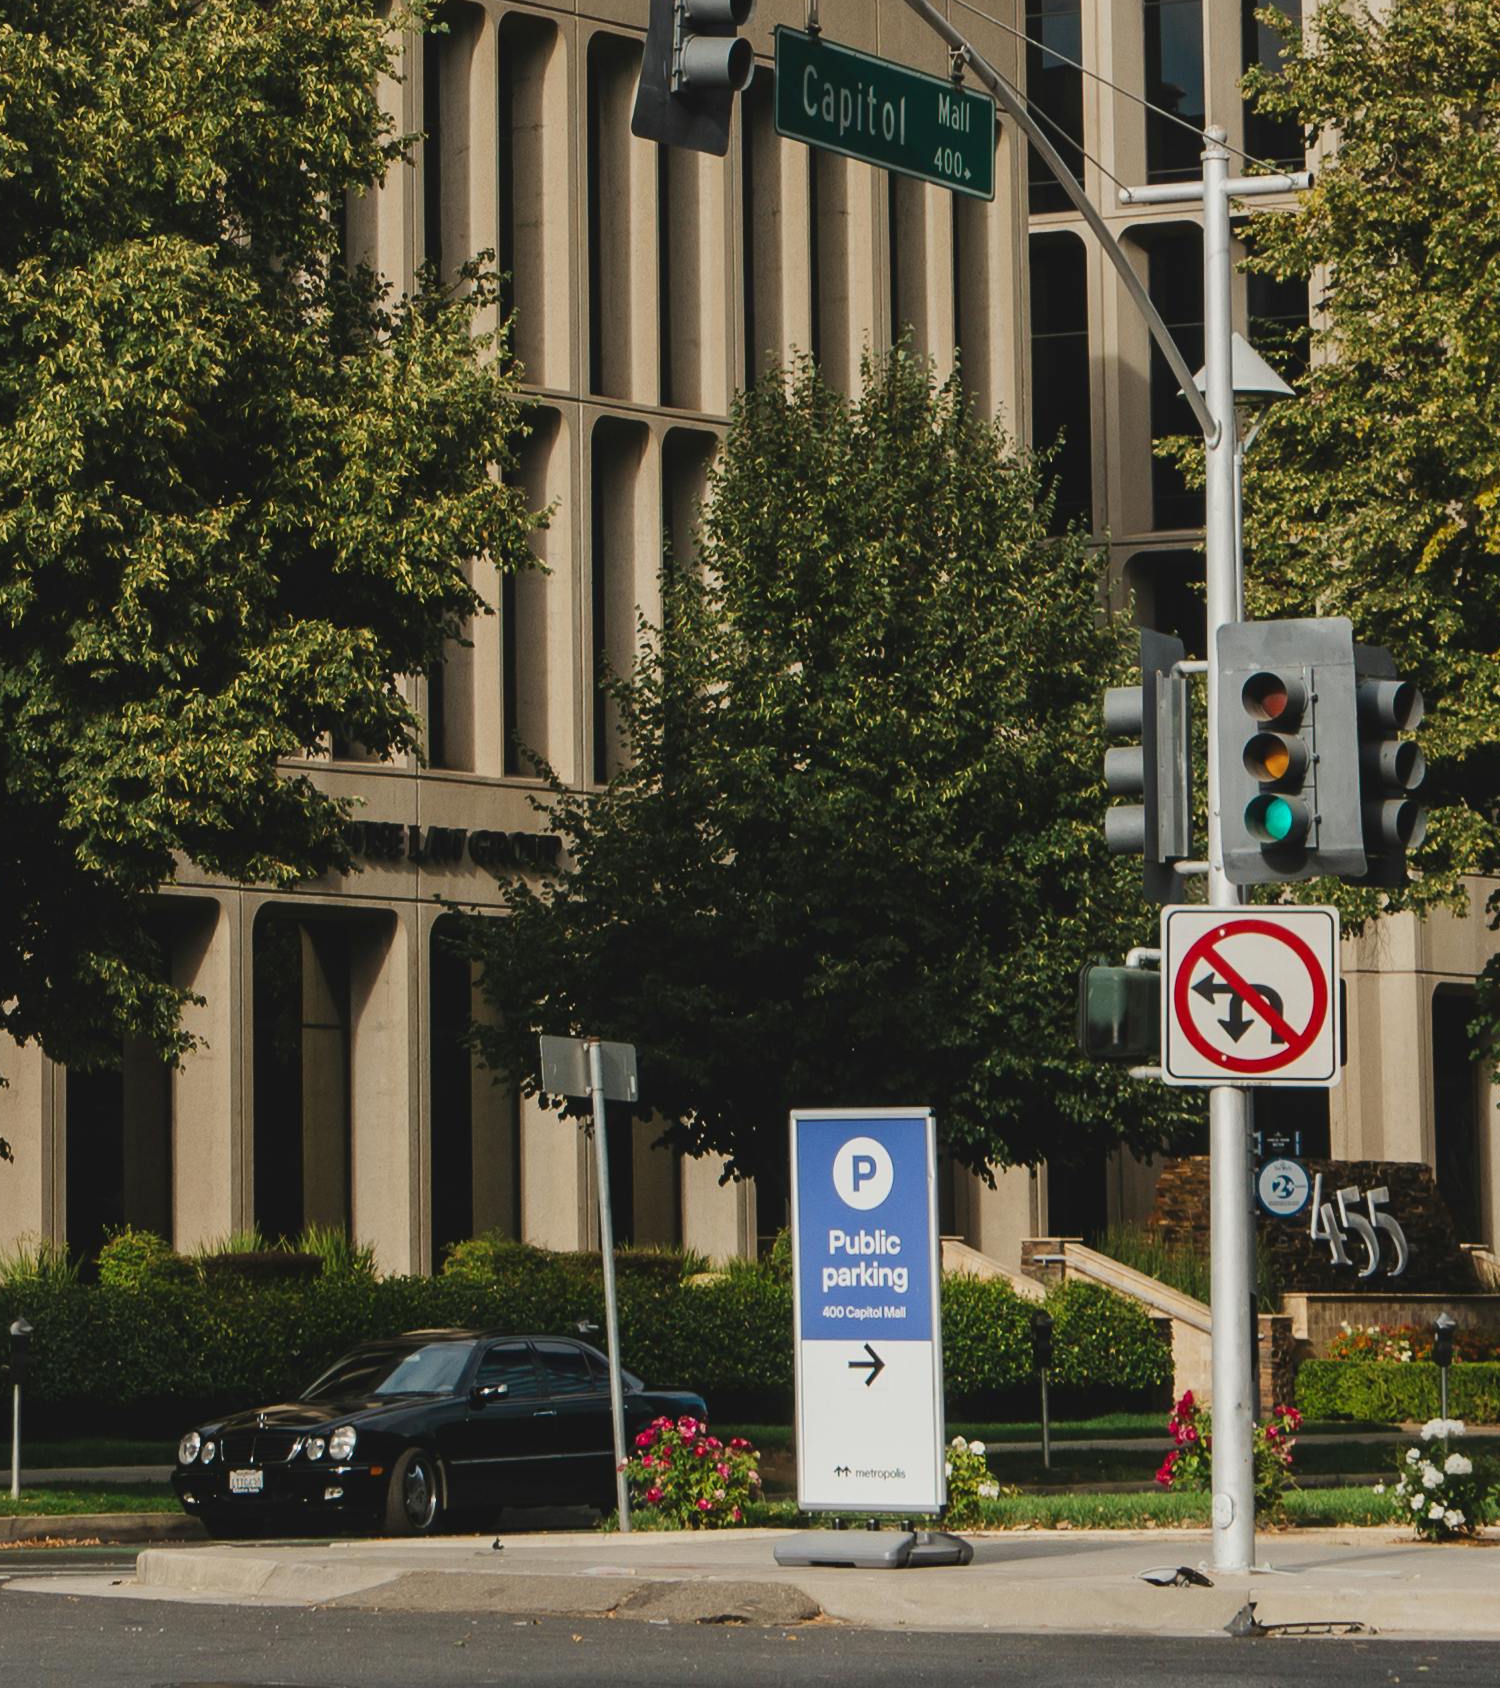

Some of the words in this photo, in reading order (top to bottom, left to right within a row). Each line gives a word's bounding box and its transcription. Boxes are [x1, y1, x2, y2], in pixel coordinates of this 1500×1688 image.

[803, 64, 906, 146] Capitol
[938, 92, 970, 133] Mall
[934, 146, 963, 178] 400
[852, 1155, 877, 1192] P
[1310, 1173, 1409, 1278] 455
[829, 1229, 902, 1255] Public
[822, 1261, 909, 1294] parking
[822, 1305, 845, 1319] 400
[845, 1305, 883, 1321] Capitol
[883, 1306, 907, 1319] Mall
[855, 1468, 906, 1480] metropolis
